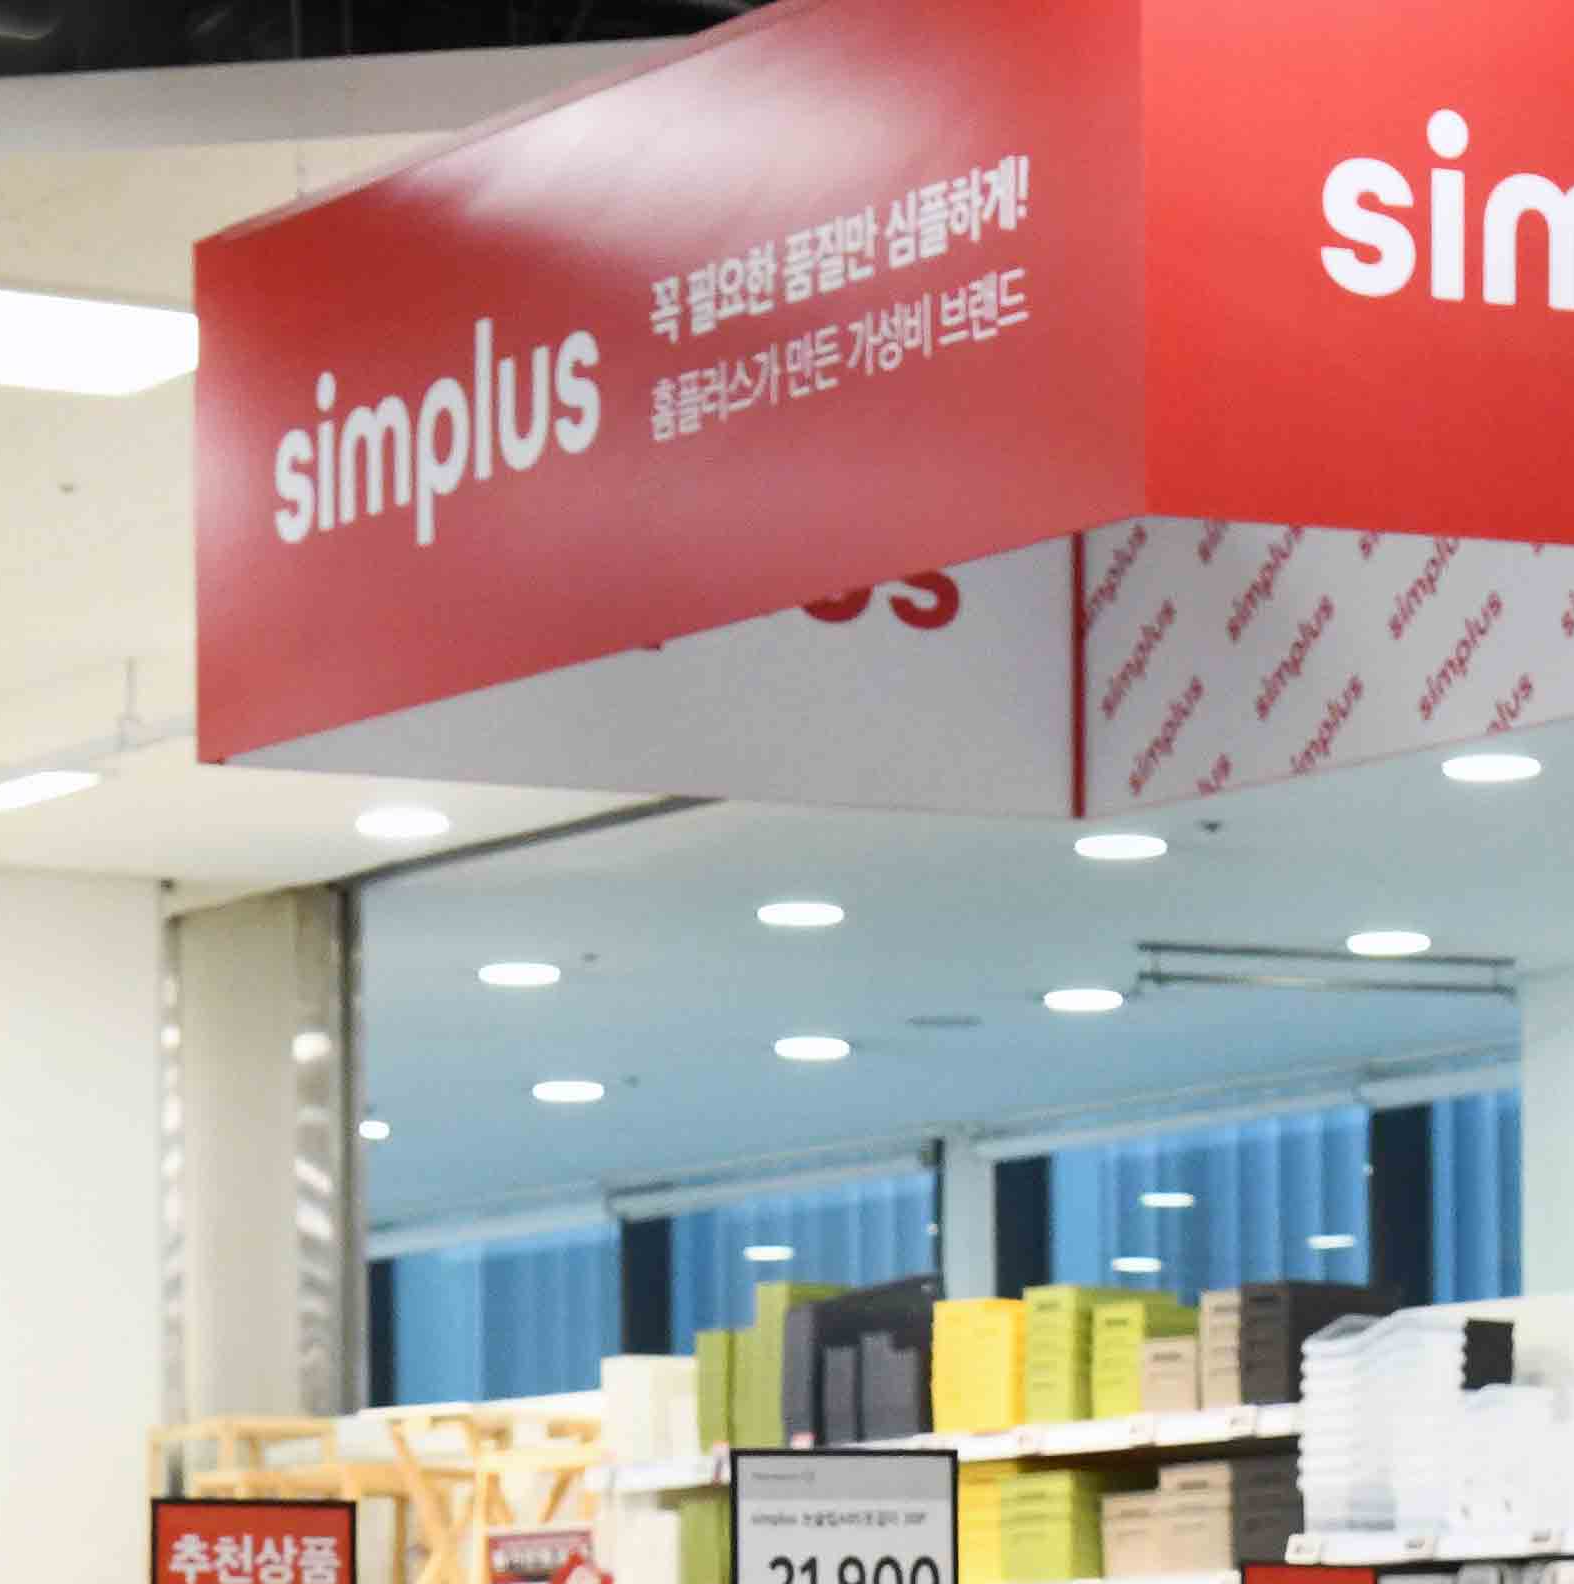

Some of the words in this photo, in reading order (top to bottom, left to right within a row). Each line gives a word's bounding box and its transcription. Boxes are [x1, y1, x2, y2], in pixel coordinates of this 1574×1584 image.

[651, 277, 681, 344] 꼭
[687, 246, 777, 330] 필요한
[783, 209, 879, 305] 품질만
[884, 152, 1031, 274] 심플하게!
[273, 316, 600, 546] simplus
[651, 343, 781, 443] 홈플러스가
[785, 324, 839, 400] 만든
[847, 298, 935, 374] 가성비
[939, 268, 1030, 348] 브랜드
[1256, 595, 1335, 721] simplus
[1420, 590, 1503, 720] simplus
